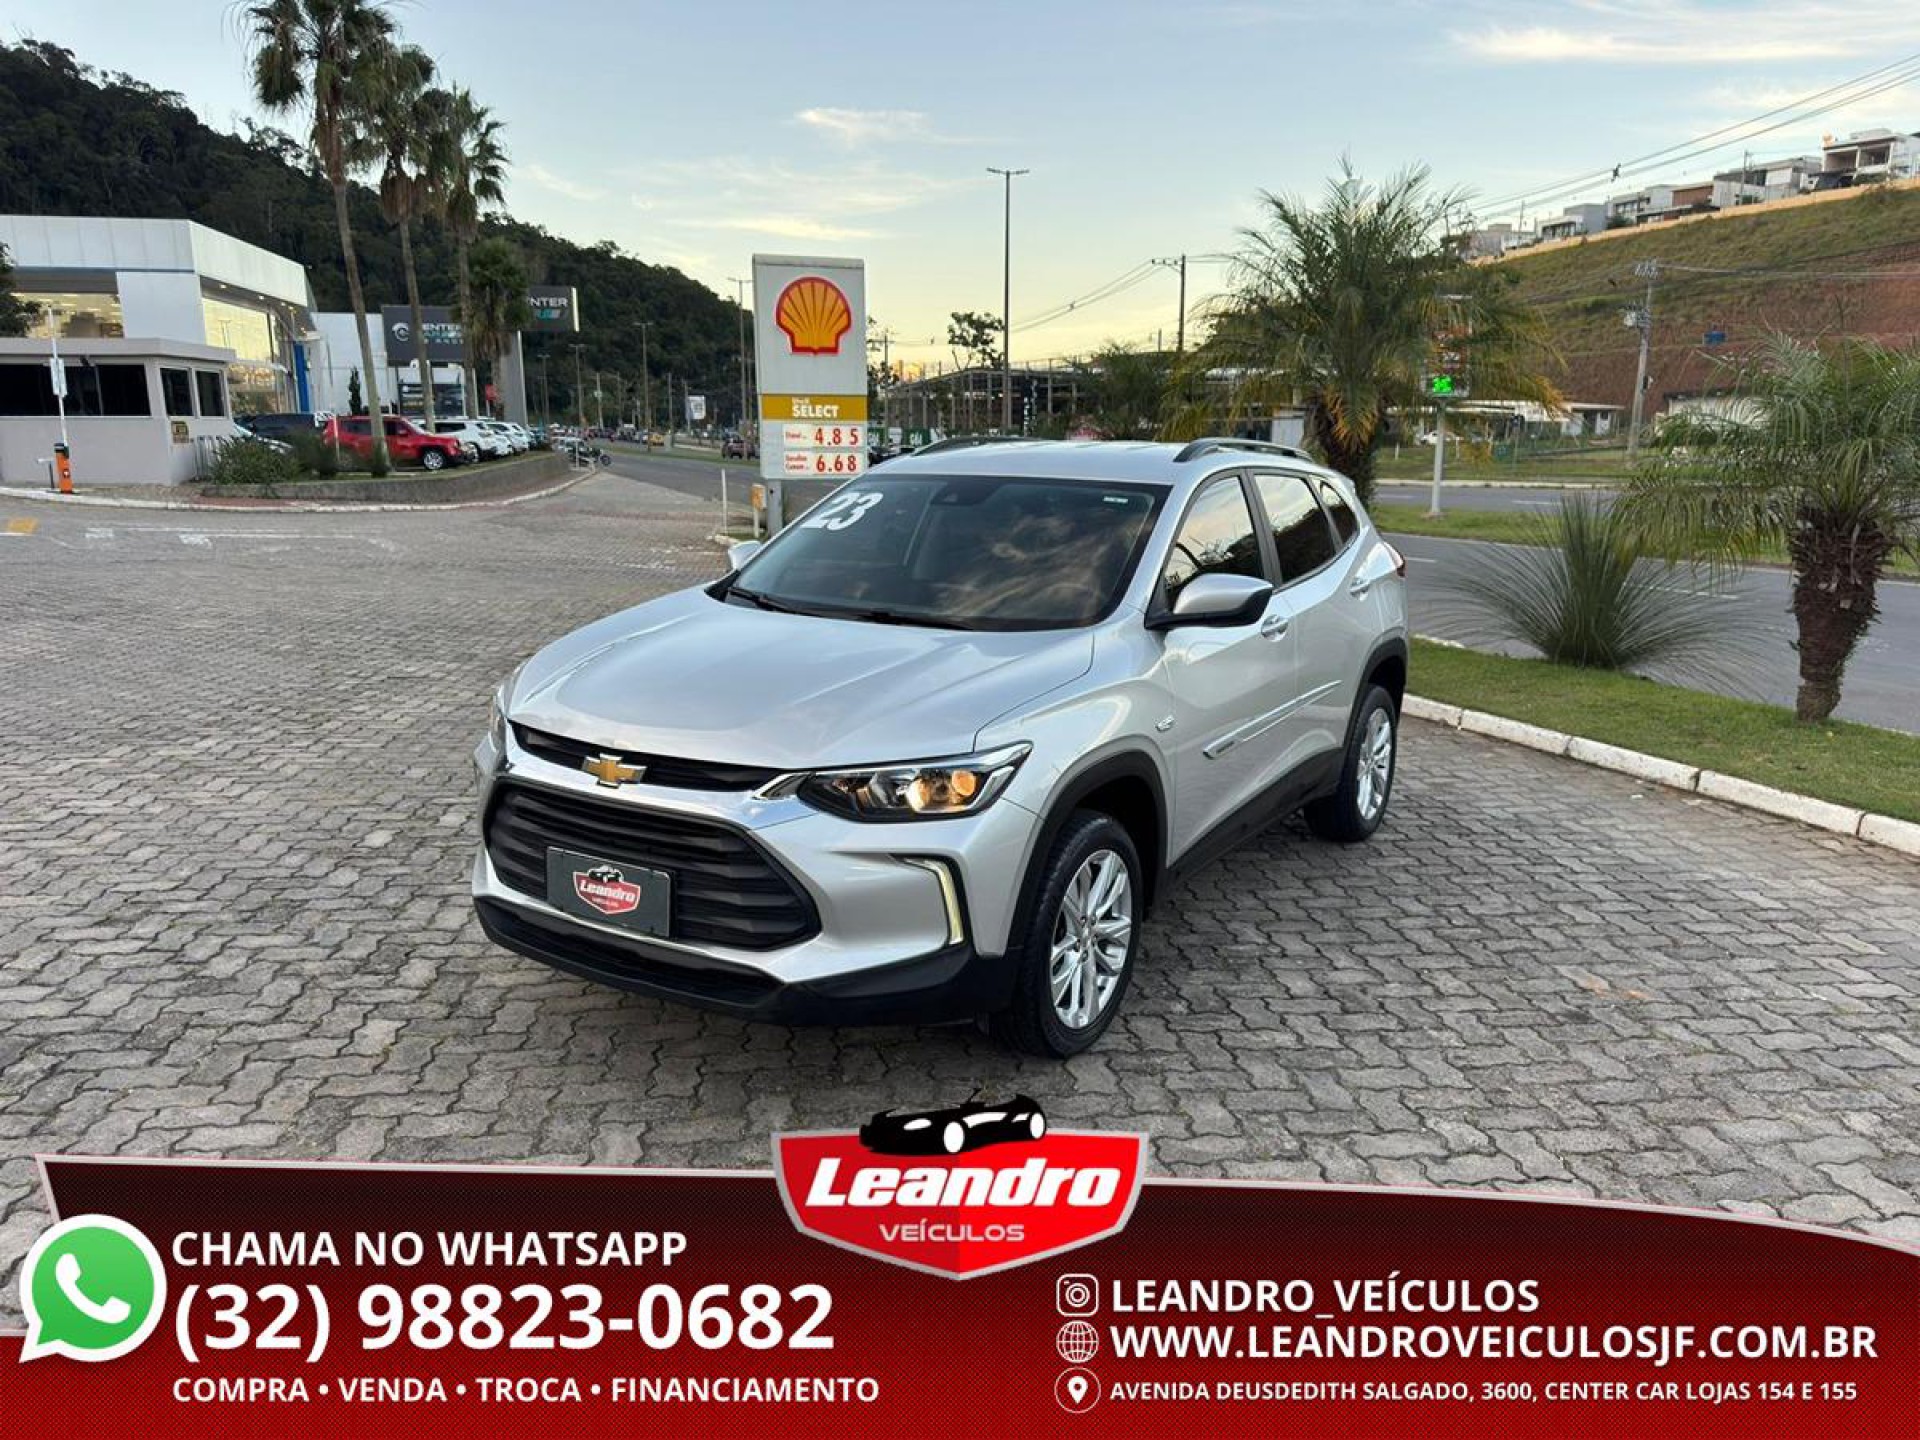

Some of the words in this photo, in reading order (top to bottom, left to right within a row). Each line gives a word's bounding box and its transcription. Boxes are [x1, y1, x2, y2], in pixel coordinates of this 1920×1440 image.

[792, 404, 839, 418] SELECT
[815, 427, 859, 446] 4.85
[816, 453, 857, 472] 6.68
[800, 492, 883, 531] 23
[580, 880, 636, 903] Leandro
